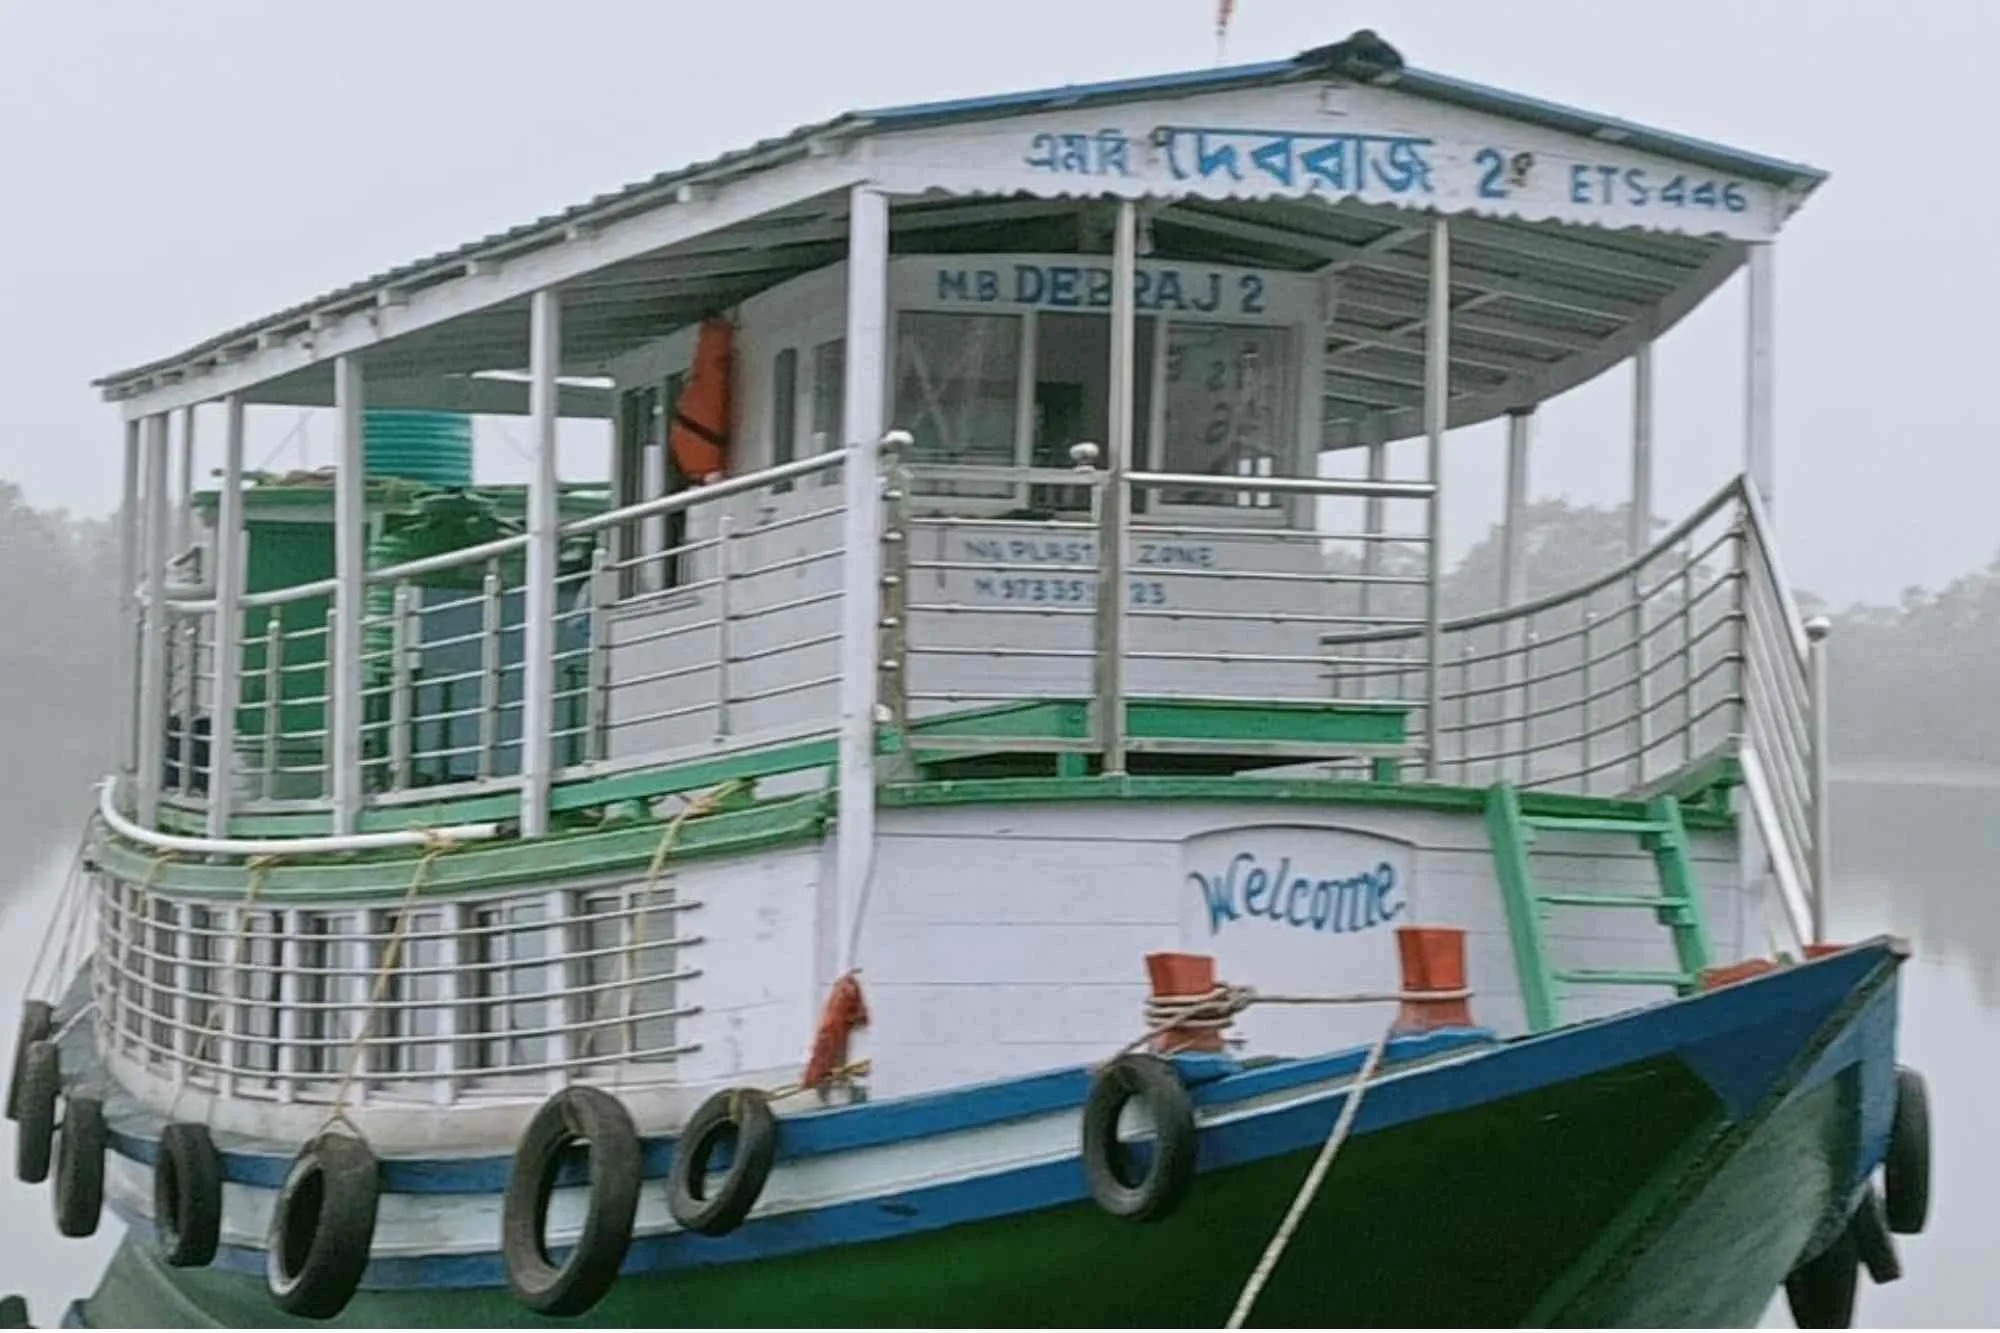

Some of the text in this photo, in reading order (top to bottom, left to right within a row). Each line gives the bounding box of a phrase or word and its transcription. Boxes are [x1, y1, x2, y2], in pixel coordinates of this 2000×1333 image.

[1164, 125, 1434, 193] দেবরাজ
[1238, 275, 1266, 314] 2
[1188, 853, 1405, 934] Welcome
